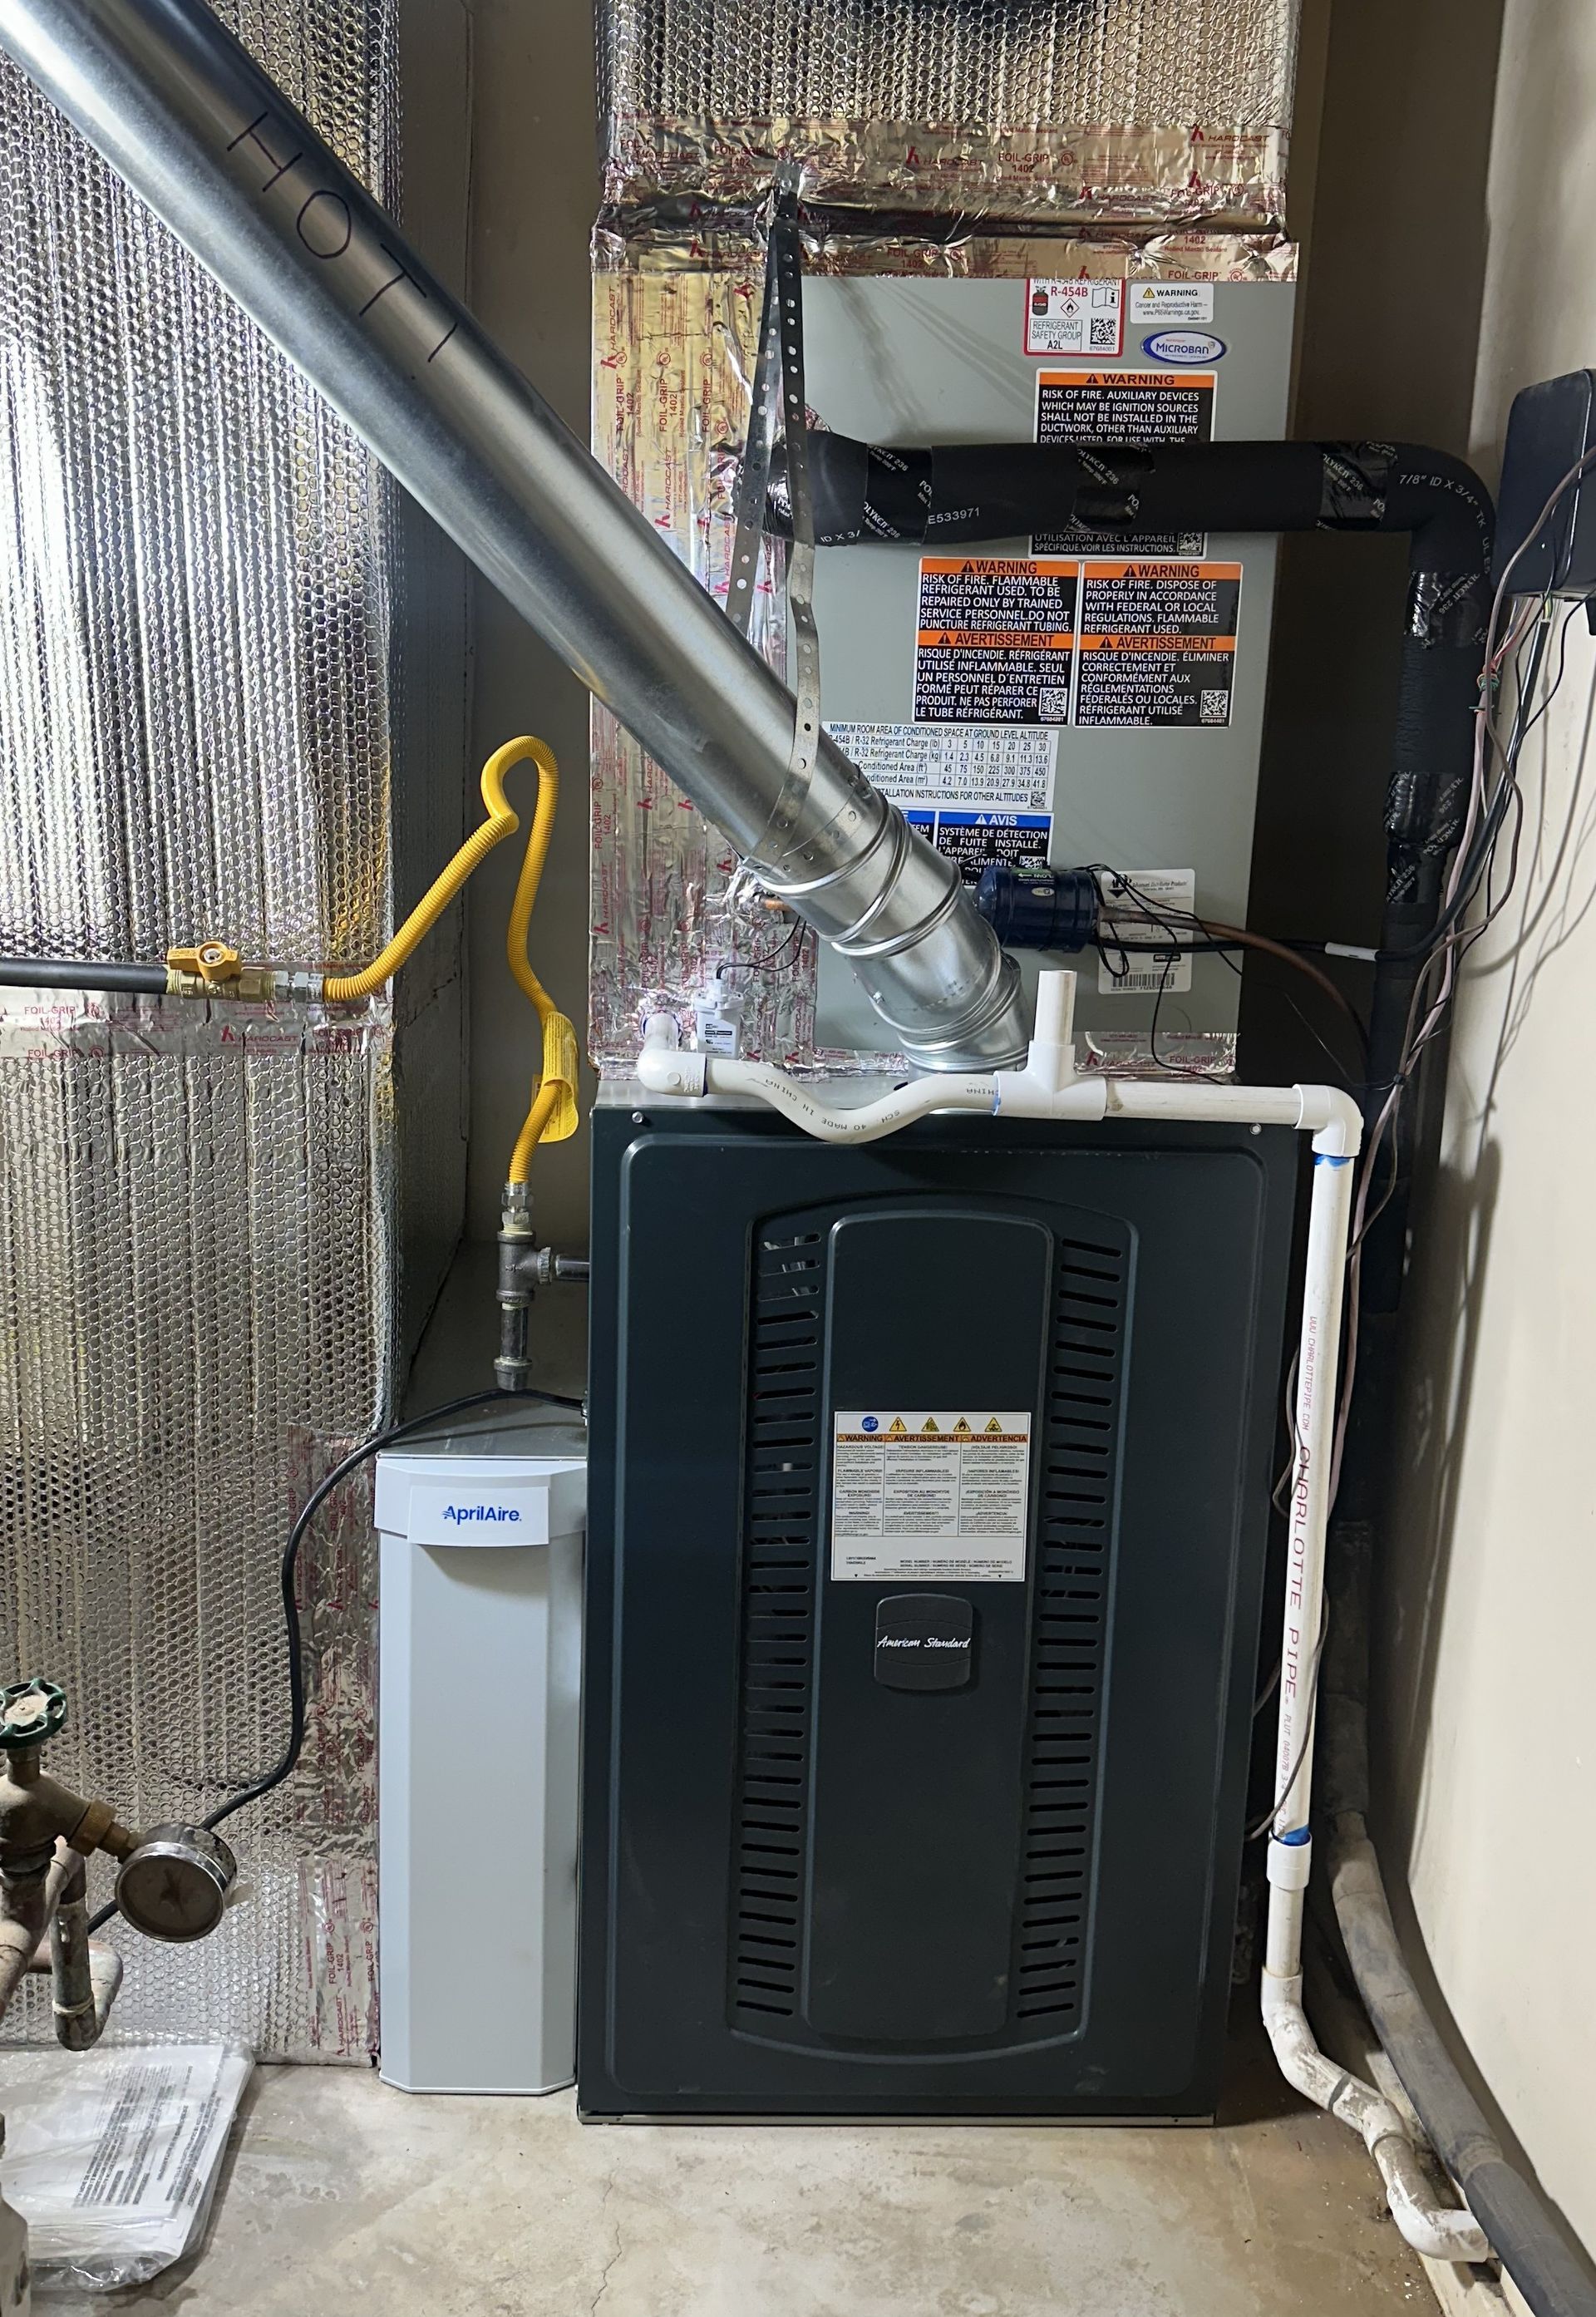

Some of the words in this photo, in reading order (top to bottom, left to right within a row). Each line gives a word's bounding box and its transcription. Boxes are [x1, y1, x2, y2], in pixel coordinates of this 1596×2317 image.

[998, 153, 1049, 163] FOIL-GRIP
[1051, 287, 1087, 297] R-454B
[1032, 322, 1079, 330] REFRIGERANT
[1057, 331, 1081, 339] GROUP
[1047, 341, 1062, 349] A2L
[1155, 343, 1209, 354] MICROBAN
[1103, 374, 1174, 385] WARNING
[1042, 390, 1062, 398] RISK
[1066, 391, 1077, 399] OF
[1081, 391, 1104, 399] FIRE.
[1107, 391, 1156, 400] AUXILIARY
[1160, 392, 1199, 401] DEVICES
[659, 377, 669, 433] FOIL-GRIP
[669, 395, 678, 417] 1402
[1042, 402, 1073, 411] WHICH
[1076, 402, 1096, 411] MAY
[1112, 403, 1154, 412] IGNITION
[1157, 404, 1198, 412] SOURCES
[1042, 413, 1070, 421] SHALL
[1074, 413, 1093, 421] NOT
[1112, 414, 1162, 422] INSTALLED
[1165, 415, 1175, 423] IN
[1179, 415, 1197, 423] THE
[1041, 424, 1093, 434] DUCTWORK,
[1096, 425, 1125, 433] OTHER
[1154, 426, 1198, 434] AUXILIARY
[664, 446, 672, 510] HARDCAST
[1430, 476, 1442, 486] ID
[1444, 481, 1455, 491] X
[928, 508, 980, 525] E533971
[976, 560, 1036, 574] WARNING
[1138, 565, 1199, 577] WARNING
[922, 574, 944, 584] RISK
[948, 575, 961, 584] OF
[964, 575, 988, 584] FIRE.
[993, 576, 1057, 586] FLAMMABLE
[1086, 580, 1108, 589] RISK
[1111, 580, 1125, 589] OF
[1129, 580, 1152, 589] FIRE.
[1156, 580, 1199, 589] DISPOSE
[1202, 581, 1216, 589] OF
[922, 584, 993, 594] REFRIGERANT
[998, 586, 1026, 595] USED.
[1030, 587, 1044, 596] TO
[1047, 587, 1059, 596] BE
[1086, 591, 1134, 599] PROPERLY
[1149, 592, 1216, 600] ACCORDANCE
[921, 597, 970, 607] REPAIRED
[973, 598, 999, 607] ONLY
[1002, 599, 1014, 608] BY
[1017, 599, 1062, 609] TRAINED
[1086, 603, 1113, 611] WITH
[1117, 603, 1161, 611] FEDERAL
[1165, 603, 1180, 611] OR
[1183, 603, 1215, 612] LOCAL
[920, 609, 961, 619] SERVICE
[1047, 611, 1069, 620] NOT
[1085, 614, 1154, 622] REGULATIONS.
[1157, 614, 1218, 623] FLAMMABLE
[919, 620, 968, 629] PUNCTURE
[971, 621, 1031, 630] REFRIGERANT
[1035, 622, 1072, 632] TUBING.
[1084, 625, 1150, 633] REFRIGERANT
[1153, 625, 1180, 633] USED.
[954, 633, 1053, 646] AVERTISSEMENT
[1116, 638, 1214, 648] AVERTISSEMENT
[918, 648, 950, 659] RISQUE
[953, 649, 1006, 659] D'INCENDIE.
[1009, 648, 1071, 661] RÉFRIGÉRANT
[1083, 652, 1118, 662] RISQUE
[1121, 653, 1179, 661] D'INCENDIE.
[1183, 651, 1228, 662] ÉLIMINER
[918, 658, 954, 670] UTILISÉ
[958, 662, 1036, 672] INFLAMMABLE.
[1039, 663, 1064, 673] SEUL
[1082, 663, 1161, 672] CORRECTEMENT
[1164, 663, 1175, 672] ET
[917, 673, 933, 682] UN
[936, 673, 995, 683] PERSONNEL
[1081, 672, 1167, 683] CONFORMÉMENT
[1170, 674, 1190, 683] AUX
[916, 682, 951, 693] FORMÉ
[954, 685, 978, 694] PEUT
[982, 683, 1023, 695] RÉPARER
[1026, 687, 1038, 695] CE
[1081, 683, 1174, 693] RÉGLEMENTATIONS
[916, 696, 956, 705] PRODUIT.
[959, 697, 971, 705] NE
[974, 698, 989, 706] PAS
[993, 698, 1037, 707] PERFORER
[1154, 696, 1196, 704] LOCALES.
[915, 707, 925, 717] LE
[929, 708, 953, 717] TUBE
[956, 707, 1022, 718] RÉFRIGÉRANT.
[1148, 704, 1182, 715] UTILISÉ
[1079, 717, 1152, 725] INFLAMMABLE.
[830, 724, 855, 733] MINIMUM
[857, 725, 874, 733] ROOM
[876, 726, 892, 734] AREA
[894, 727, 901, 735] OF
[903, 727, 943, 736] CONDITIONED
[944, 728, 963, 737] SPACE
[964, 729, 973, 737] AT
[973, 729, 999, 738] GROUND
[1000, 730, 1017, 739] LEVEL
[1019, 731, 1047, 740] ALTITUDE
[594, 801, 603, 850] FOIL-GRIP
[603, 814, 612, 836] 1402
[988, 816, 1017, 826] AVIS
[938, 826, 979, 836] SYSTÈME
[997, 828, 1047, 839] DÉTECTION
[995, 838, 1040, 848] INSTALLÉ.
[821, 1117, 847, 1131] MADE
[442, 1506, 520, 1525] AprilAire
[1289, 1447, 1311, 1610] CHARLOTTE
[877, 1635, 921, 1648] American
[924, 1637, 971, 1649] Standard
[327, 1942, 336, 1984] FOIL-GRIP
[336, 1954, 344, 1972] 1402
